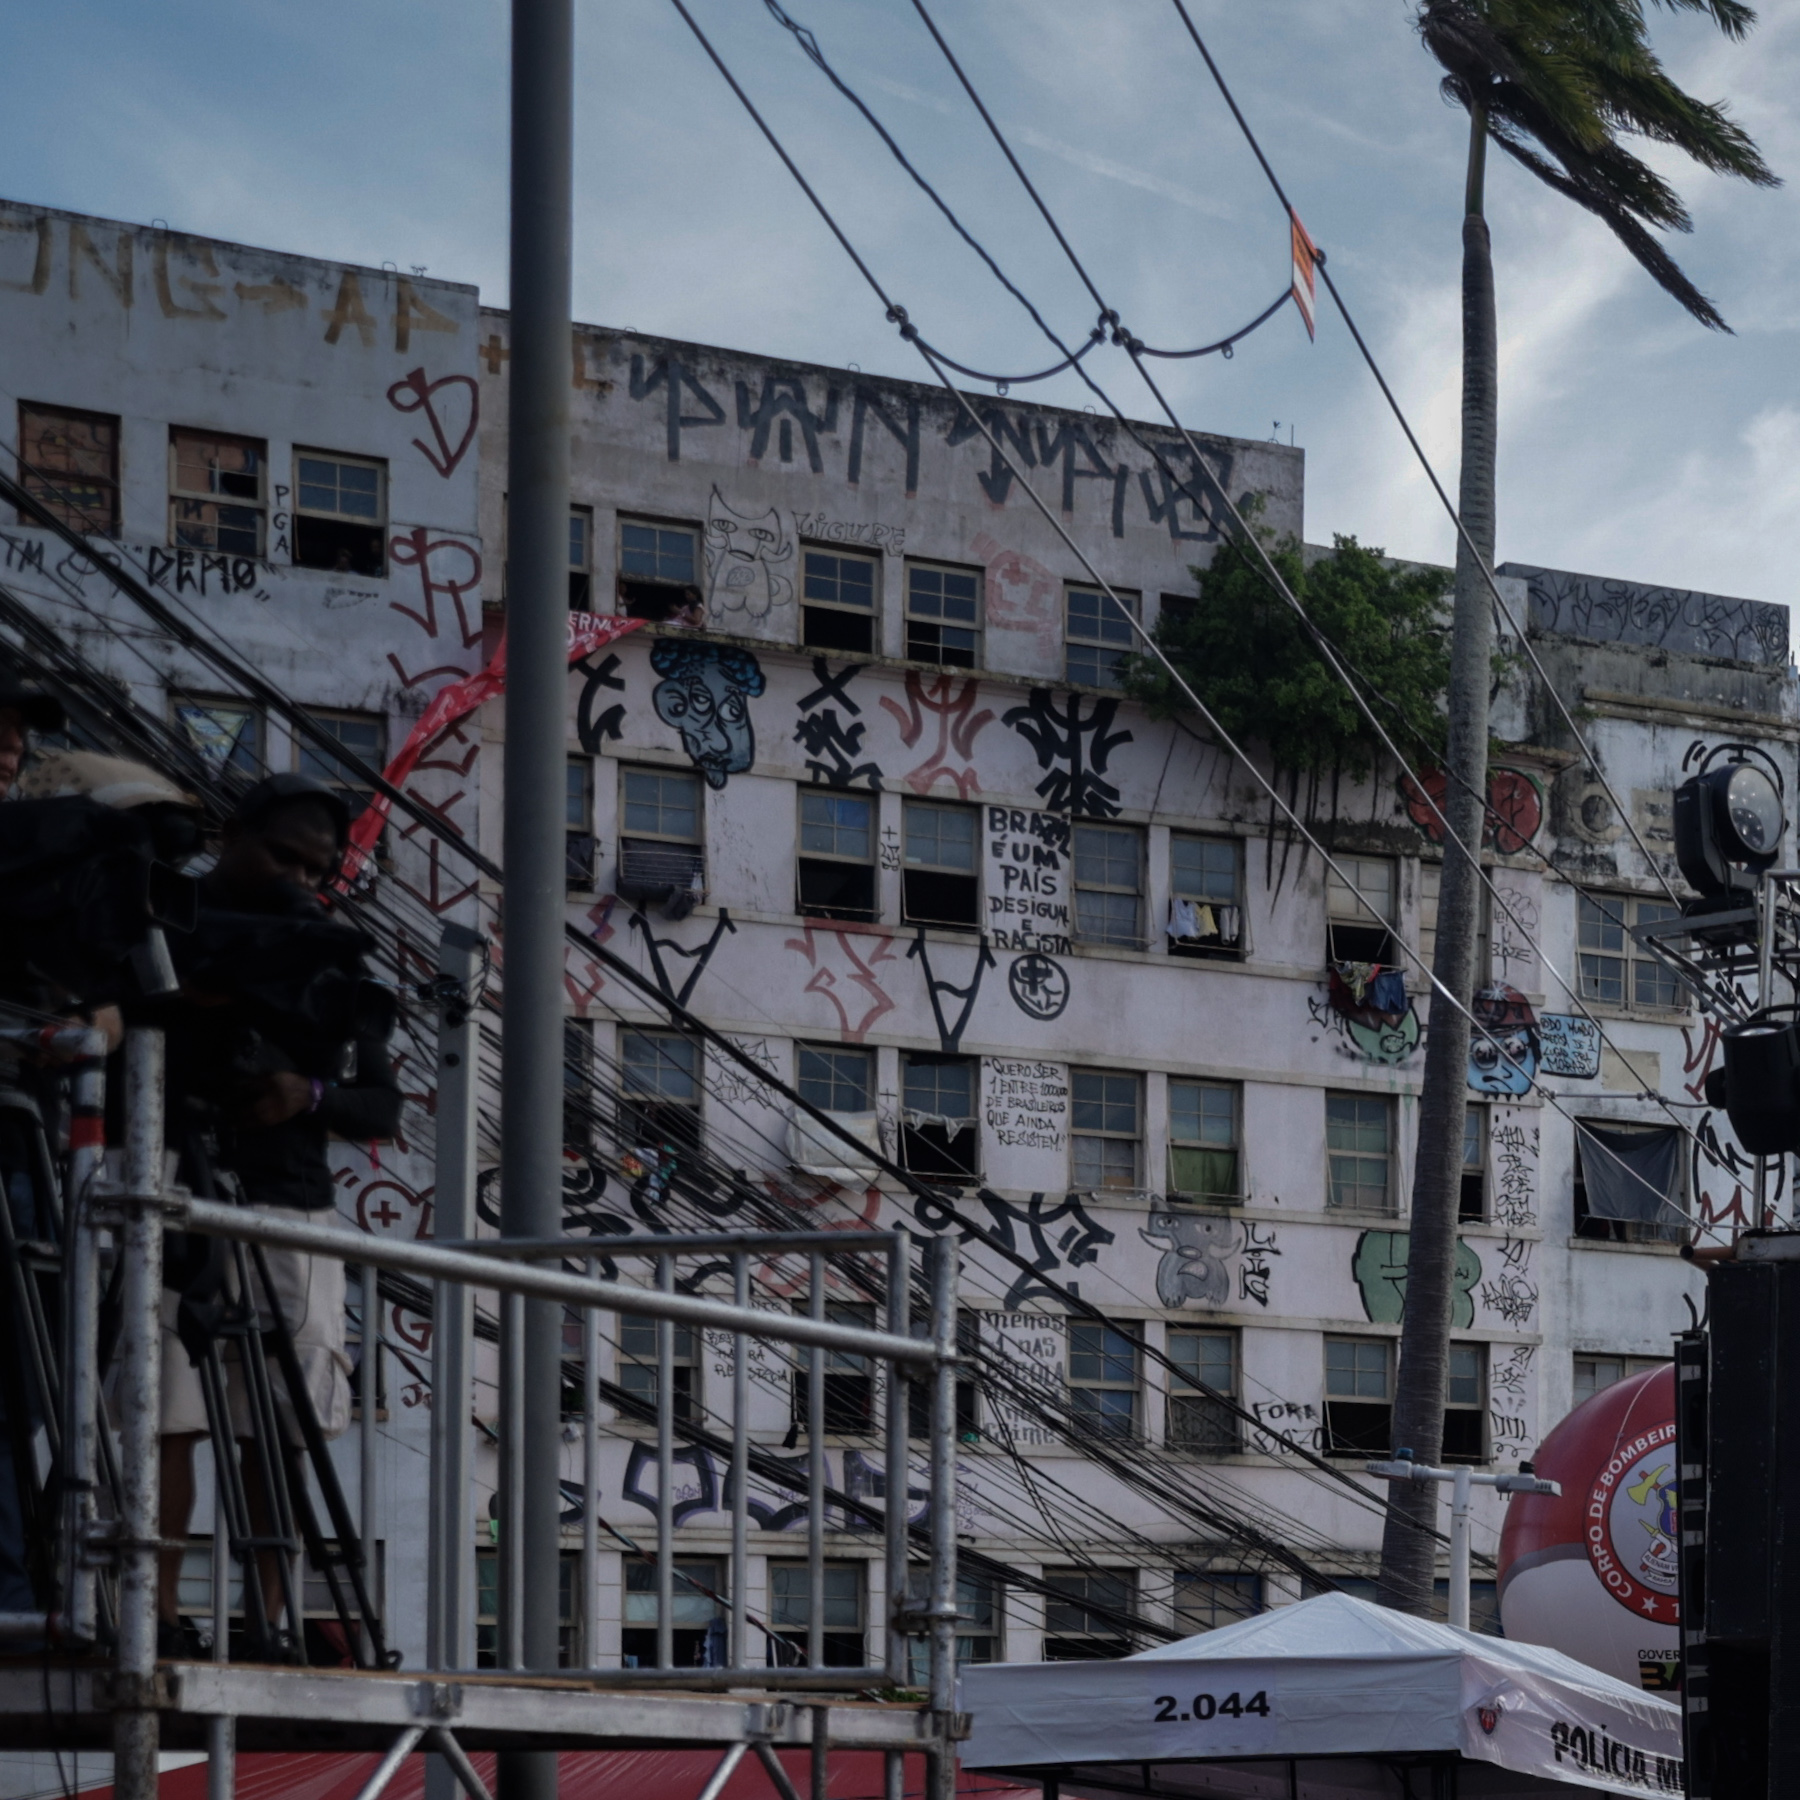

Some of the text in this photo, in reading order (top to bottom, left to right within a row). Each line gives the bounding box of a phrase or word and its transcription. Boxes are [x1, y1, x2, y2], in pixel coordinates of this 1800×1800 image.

[991, 833, 1061, 870] É UM
[999, 864, 1057, 895] PAÍS
[1021, 918, 1033, 932] E
[985, 1096, 1002, 1108] DE
[1000, 1079, 1038, 1097] ENTRE
[986, 1109, 1056, 1132] QUE AINDA
[1252, 1400, 1319, 1422] FORA
[1588, 1486, 1608, 1519] DE
[1588, 1524, 1633, 1599] CORPO
[1153, 1690, 1271, 1723] 2.044
[1550, 1721, 1650, 1788] POLÍCIA
